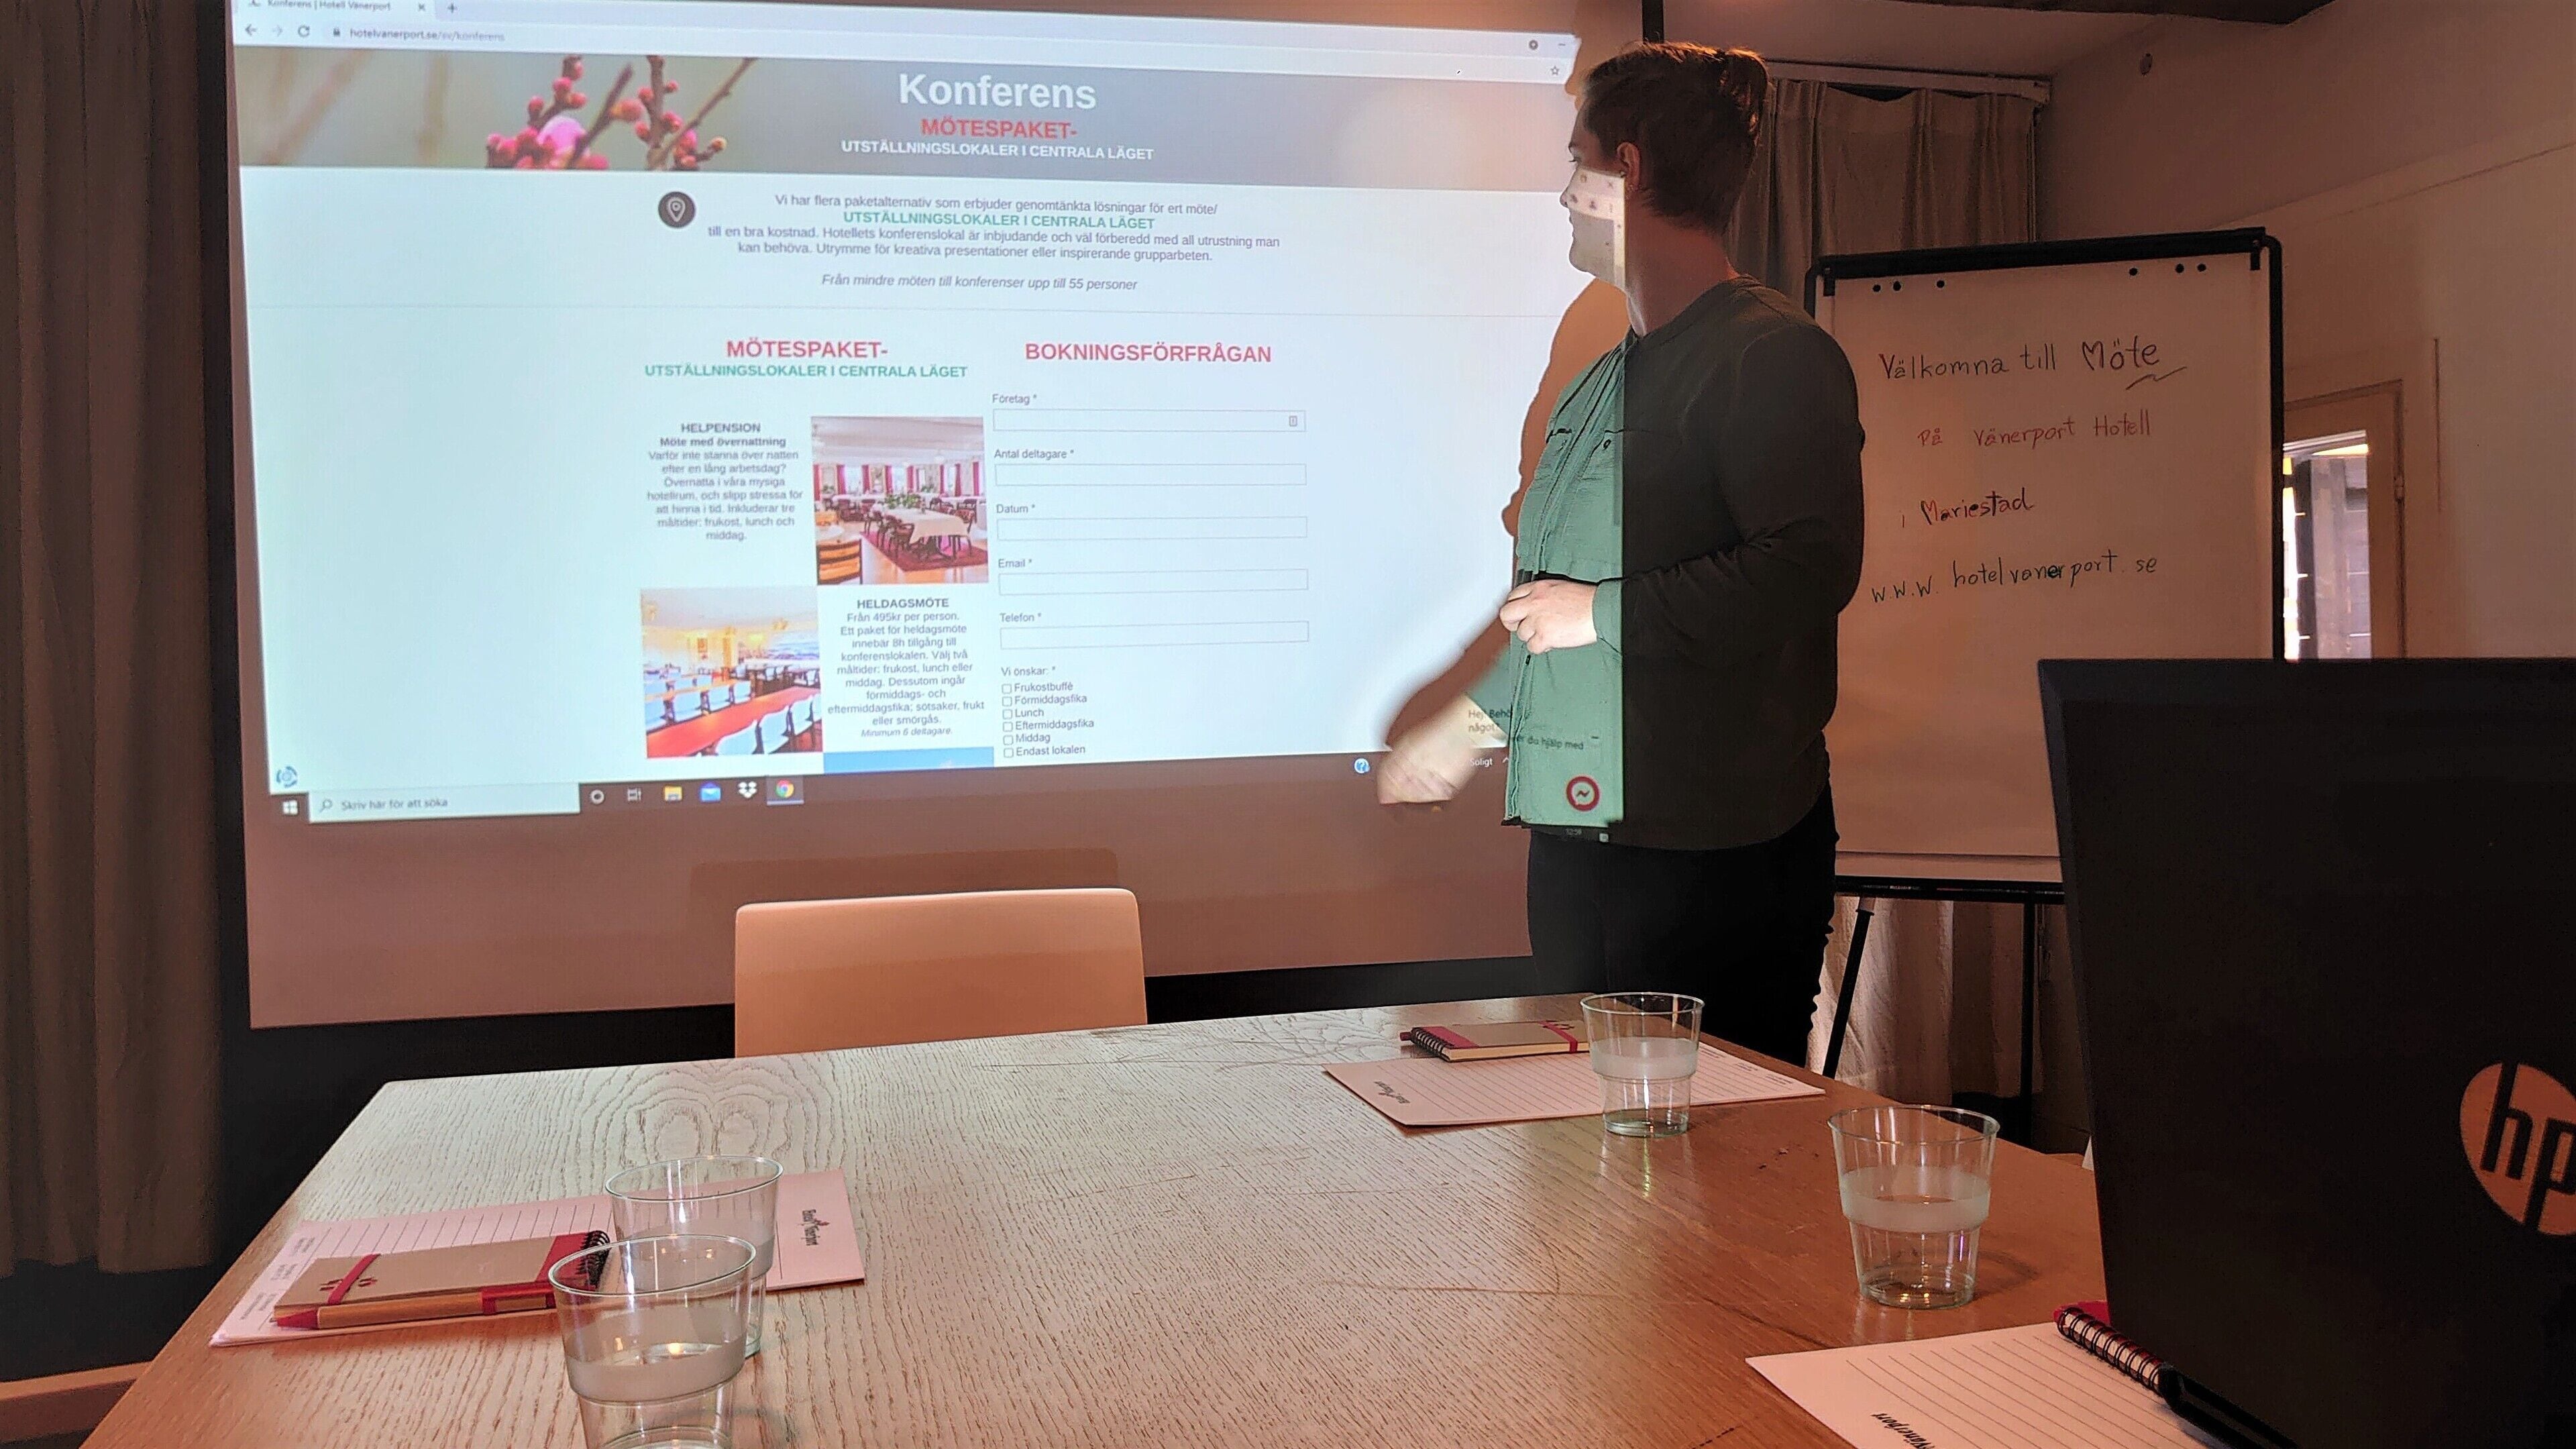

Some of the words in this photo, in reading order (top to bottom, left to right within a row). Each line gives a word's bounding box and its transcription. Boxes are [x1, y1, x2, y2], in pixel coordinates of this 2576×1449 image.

[899, 74, 1096, 109] Konferens
[920, 116, 1077, 139] MÖTESPAKET-
[842, 139, 1018, 156] UTSTÄLLNINGSLOKALER
[1022, 147, 1026, 156] I
[1030, 147, 1105, 159] CENTRALA
[1108, 145, 1154, 160] LÄGET
[775, 195, 788, 205] Vi
[791, 195, 810, 206] har
[814, 195, 841, 207] flera
[845, 195, 932, 209] paketalternativ
[936, 200, 960, 209] som
[964, 198, 1012, 211] erbjuder
[1016, 200, 1091, 214] genomtänkta
[1094, 201, 1146, 215] lösningar
[1149, 203, 1164, 213] för
[1168, 205, 1183, 214] ert
[844, 209, 1020, 226] UTSTÄLLNINGSLOKALER
[1024, 216, 1027, 226] I
[1031, 216, 1106, 228] CENTRALA
[1110, 215, 1155, 229] LÄGET
[708, 227, 721, 237] till
[726, 229, 738, 237] en
[744, 227, 764, 237] bra
[768, 227, 818, 238] kostnad.
[823, 229, 875, 239] Hotellets
[879, 229, 964, 240] konferenslokal
[969, 231, 980, 241] är
[984, 231, 1047, 244] inbjudande
[1052, 233, 1072, 243] och
[1075, 232, 1093, 244] väl
[1096, 233, 1150, 244] förberedd
[1154, 234, 1178, 245] med
[1182, 235, 1194, 245] all
[1198, 235, 1252, 249] utrustning
[1256, 238, 1280, 247] man
[738, 243, 760, 253] kan
[764, 243, 812, 254] behöva.
[816, 244, 871, 256] Utrymme
[875, 244, 890, 254] för
[894, 245, 941, 256] kreativa
[945, 246, 1029, 259] presentationer
[1032, 247, 1057, 258] eller
[1060, 248, 1130, 260] inspirerande
[1134, 250, 1213, 262] grupparbeten.
[822, 274, 850, 285] Från
[853, 275, 894, 286] mindre
[898, 276, 935, 286] möten
[939, 276, 951, 286] till
[955, 276, 1024, 288] konferenser
[1028, 280, 1050, 290] upp
[1053, 278, 1066, 288] till
[1069, 278, 1083, 288] 55
[1086, 280, 1137, 291] personer
[727, 337, 888, 358] MÖTESPAKET-
[1025, 341, 1271, 363] BOKNINGSFÖRFRÅGAN
[1879, 353, 2009, 379] Välkomna
[2020, 343, 2055, 370] till
[2082, 335, 2159, 371] Möte
[645, 363, 827, 377] UTSTÄLLNINGSLOKALER
[831, 366, 835, 376] I
[839, 365, 917, 378] CENTRALA
[920, 364, 968, 378] LÄGET
[992, 393, 1030, 406] Företag
[681, 423, 761, 433] HELPENSION
[1974, 416, 2076, 449] Vänerport
[2093, 409, 2150, 436] Hotell
[660, 437, 686, 446] Möte
[690, 437, 713, 446] med
[717, 437, 786, 447] övernattning
[994, 449, 1019, 458] Antal
[1022, 449, 1067, 461] deltagare
[996, 504, 1028, 514] Datum
[1921, 487, 2035, 525] Mariestad
[998, 558, 1025, 568] Email
[857, 597, 949, 609] HELDAGSMÖTE
[847, 612, 869, 622] Från
[873, 612, 900, 621] 495kr
[904, 614, 920, 624] per
[923, 614, 959, 623] person.
[1000, 612, 1034, 622] Telefon
[857, 627, 885, 637] paket
[888, 626, 900, 634] för
[904, 625, 967, 636] heldagsmöte
[908, 637, 943, 649] tillgång
[946, 637, 956, 646] till
[841, 651, 928, 661] konferenslokalen.
[932, 650, 950, 661] Välj
[953, 649, 968, 659] två
[922, 663, 949, 672] lunch
[952, 663, 973, 672] eller
[1001, 667, 1010, 676] Vi
[888, 677, 938, 686] Dessutom
[941, 675, 965, 687] ingår
[867, 690, 925, 701] förmiddags-
[928, 689, 946, 698] och
[1014, 694, 1087, 707] Förmiddagsfika
[963, 701, 984, 710] frukt
[1015, 708, 1044, 717] Lunch
[873, 716, 893, 725] eller
[1016, 719, 1094, 731] Eftermiddagsfika
[1016, 733, 1051, 744] Middag
[1016, 747, 1049, 756] Endast
[1052, 745, 1085, 755] lokalen
[1565, 741, 1583, 749] med
[2479, 1060, 2576, 1238] hp
